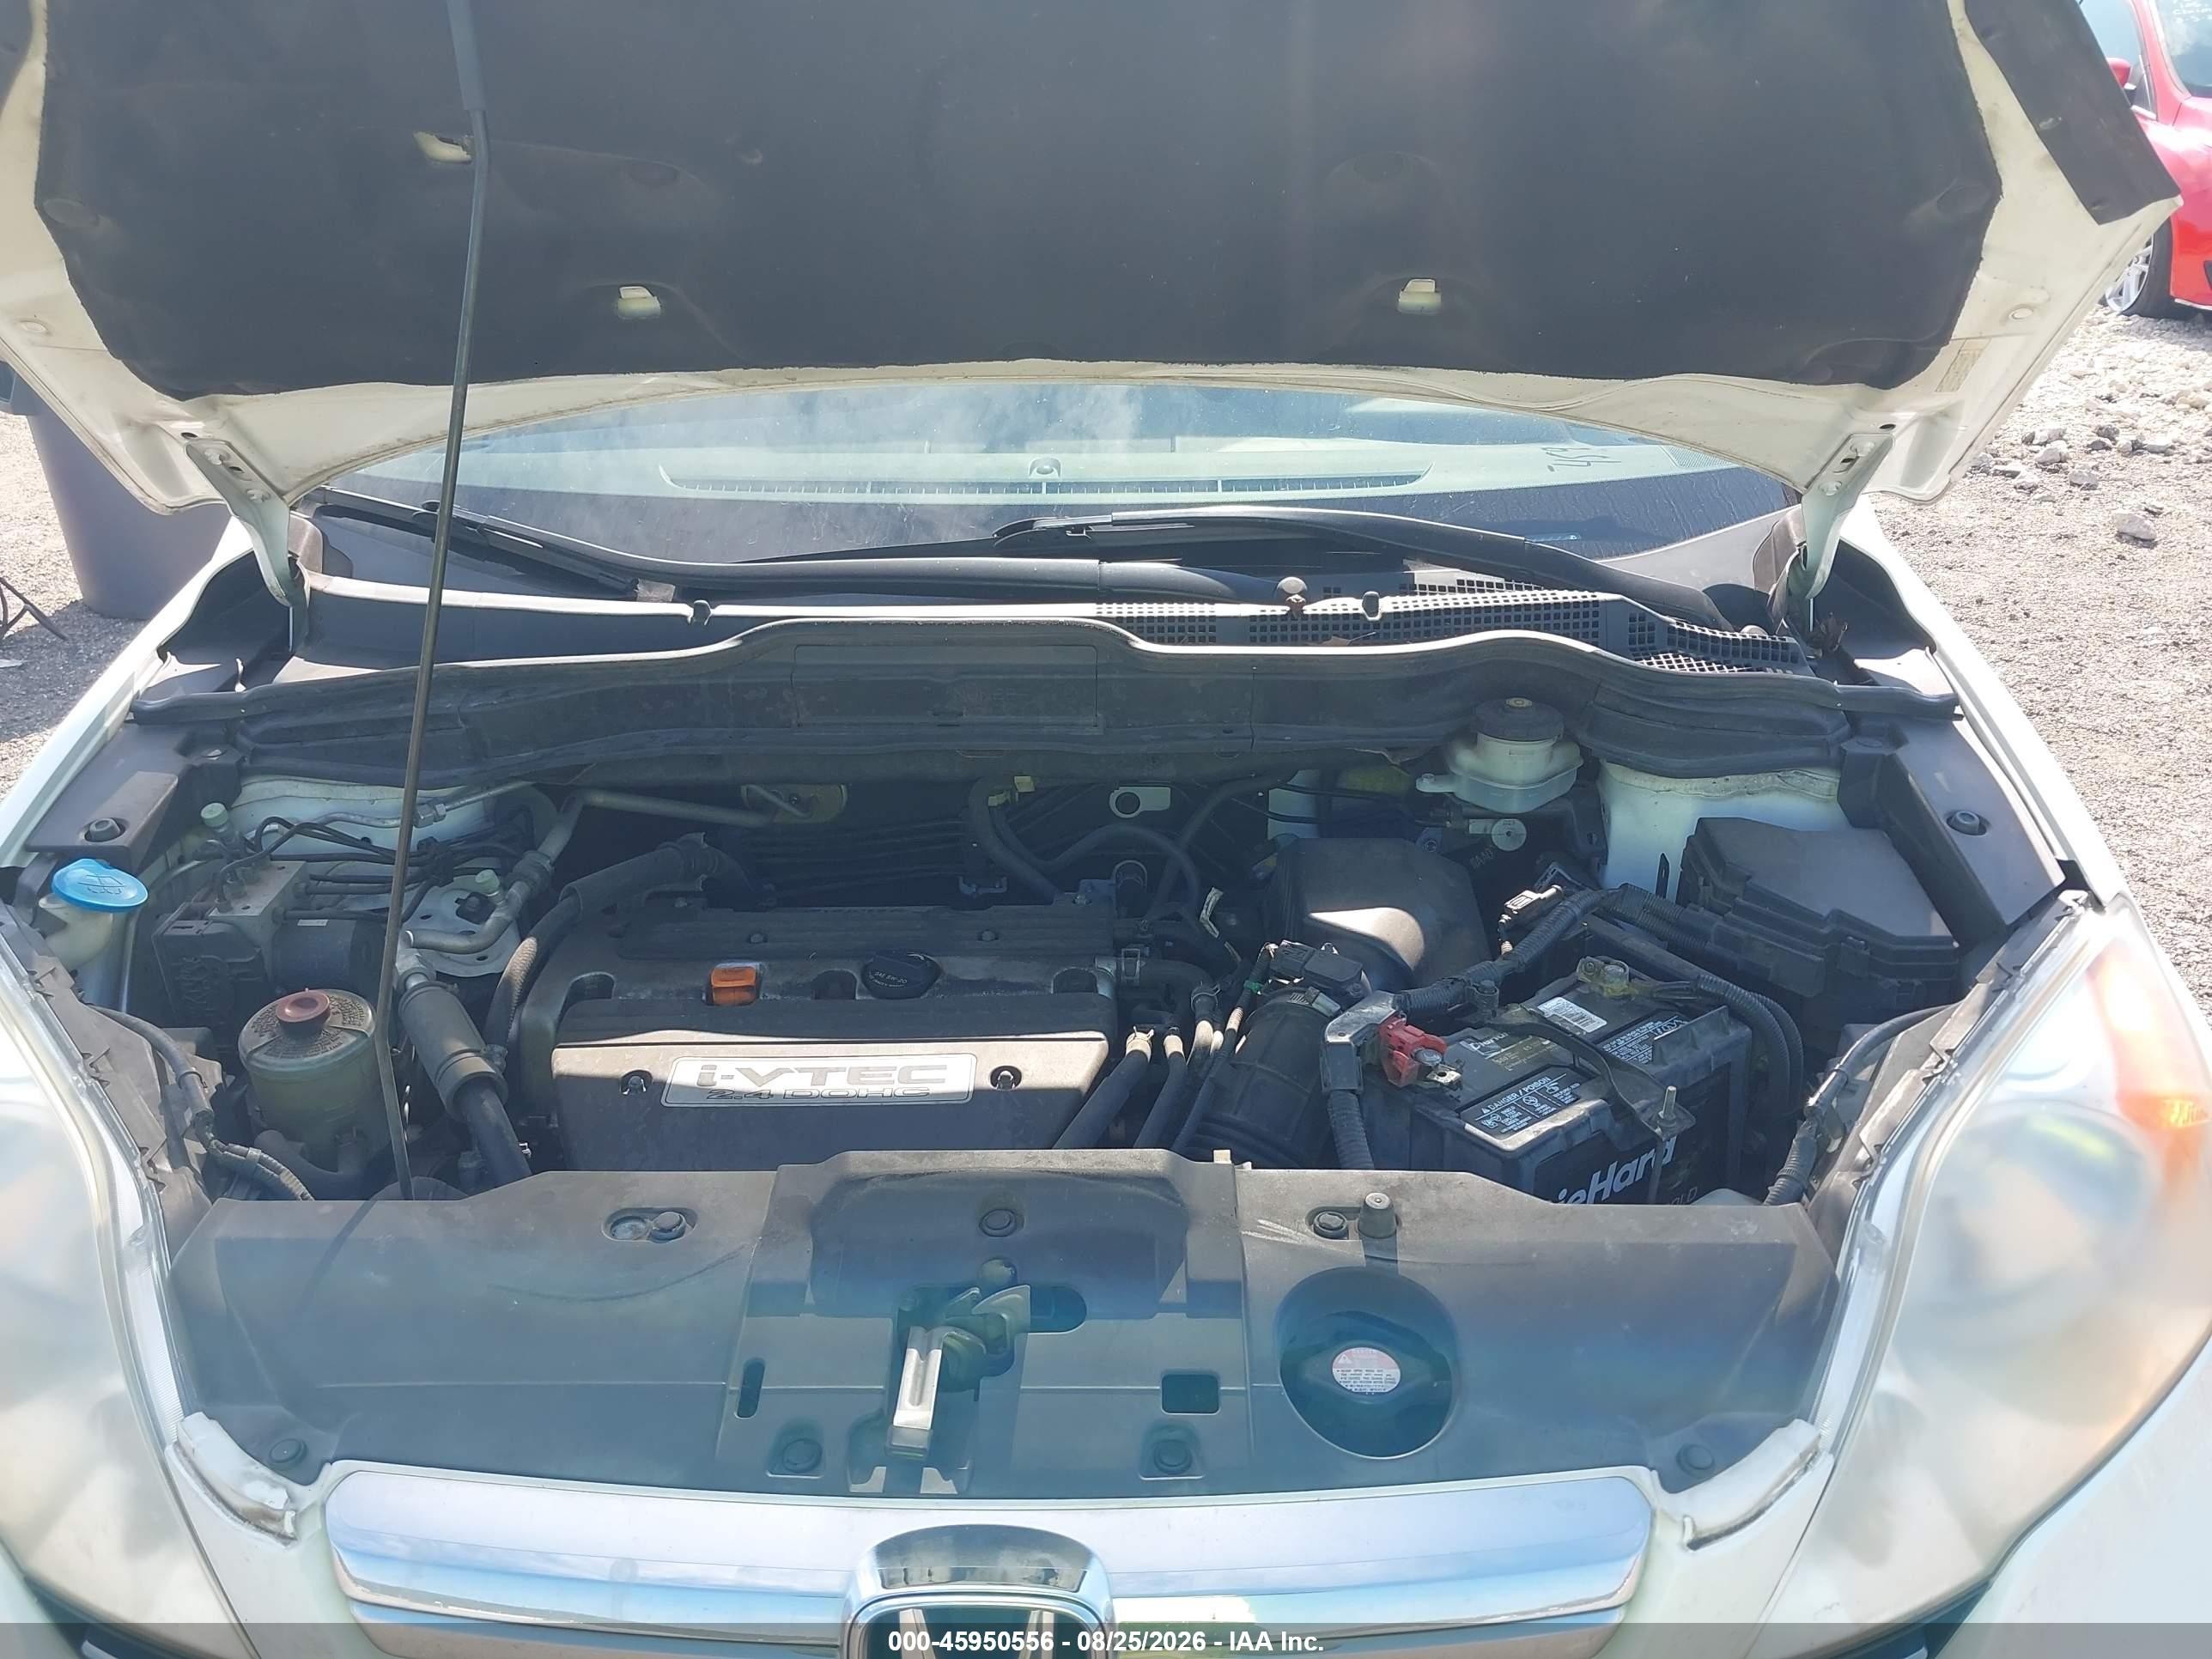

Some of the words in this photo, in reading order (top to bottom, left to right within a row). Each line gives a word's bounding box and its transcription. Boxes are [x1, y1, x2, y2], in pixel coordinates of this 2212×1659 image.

[696, 1064, 947, 1087] i-VTEC
[706, 1088, 774, 1100] 2.4
[782, 1086, 931, 1100] DOHC
[1487, 1092, 1521, 1111] DANGER
[1522, 1076, 1553, 1094] POISON
